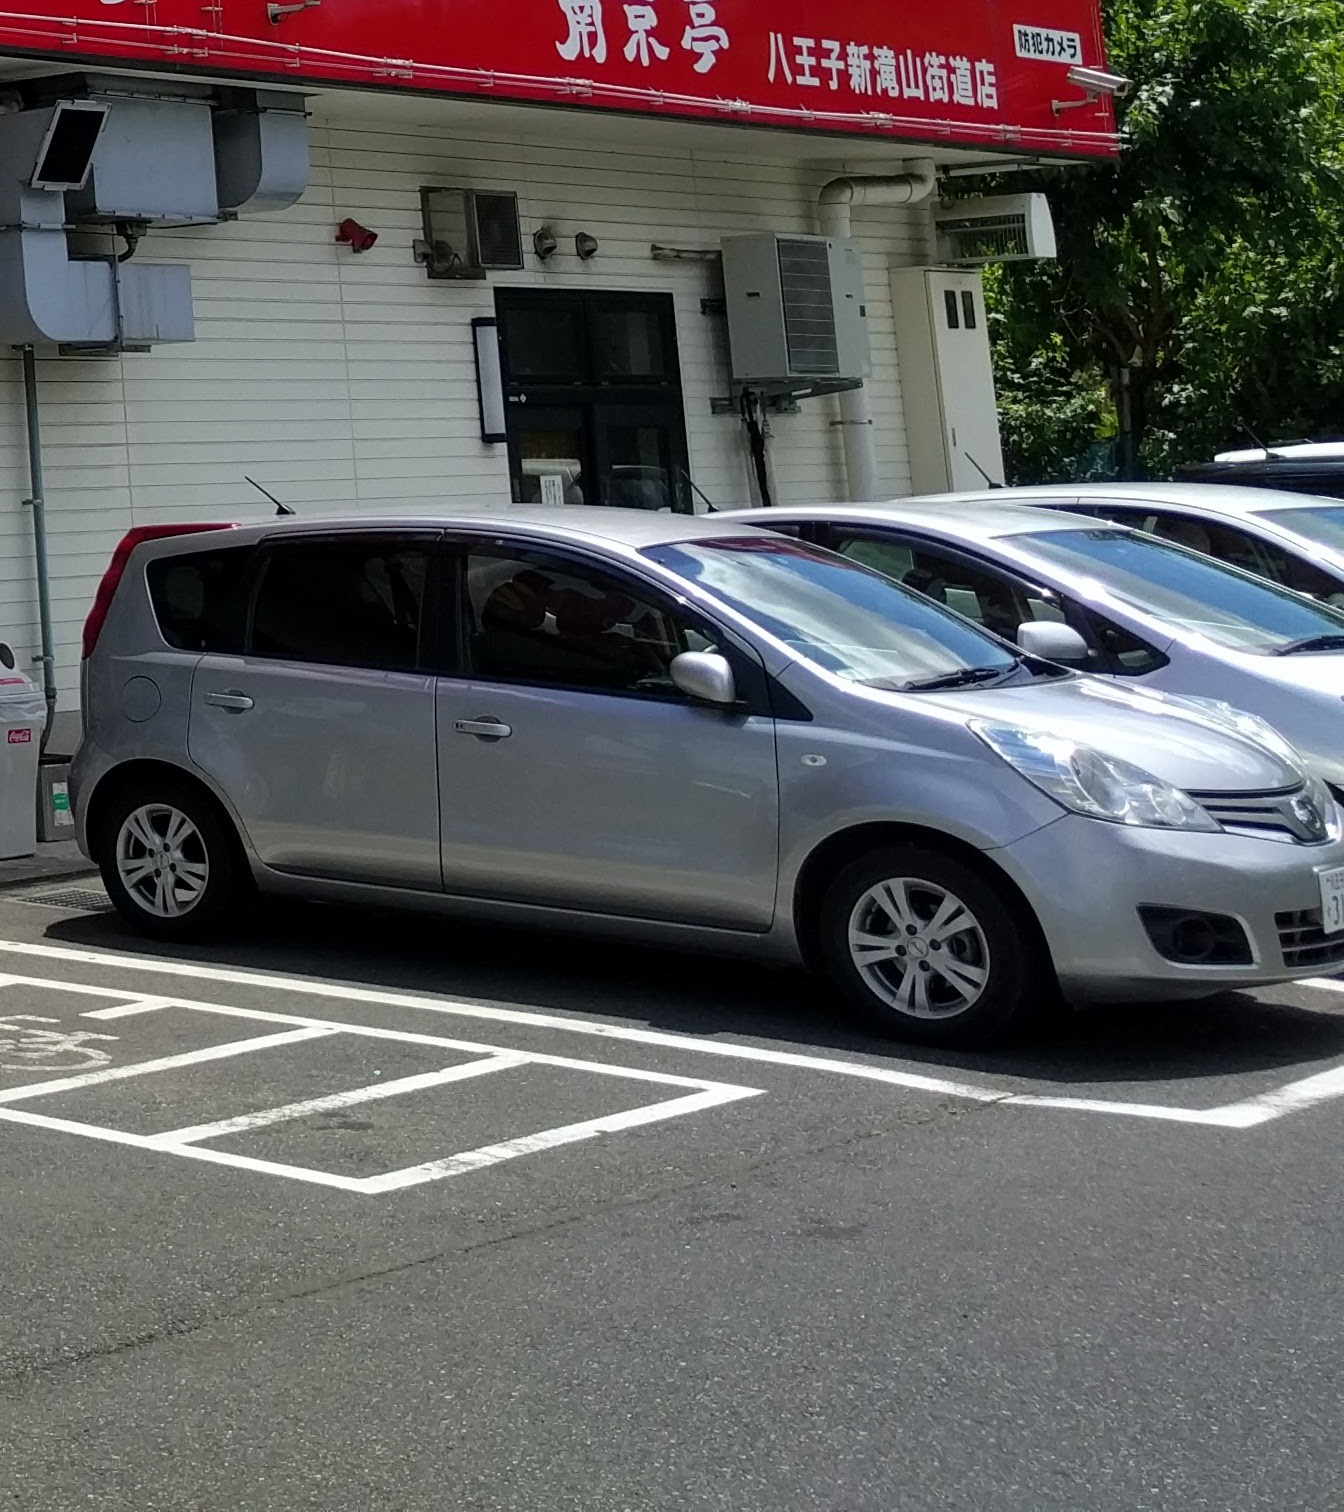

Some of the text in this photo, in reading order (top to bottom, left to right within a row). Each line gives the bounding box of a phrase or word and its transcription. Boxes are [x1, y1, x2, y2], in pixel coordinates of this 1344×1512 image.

[768, 32, 999, 109] 八王子新滝山街道店
[1017, 28, 1078, 60] 防犯カメラ
